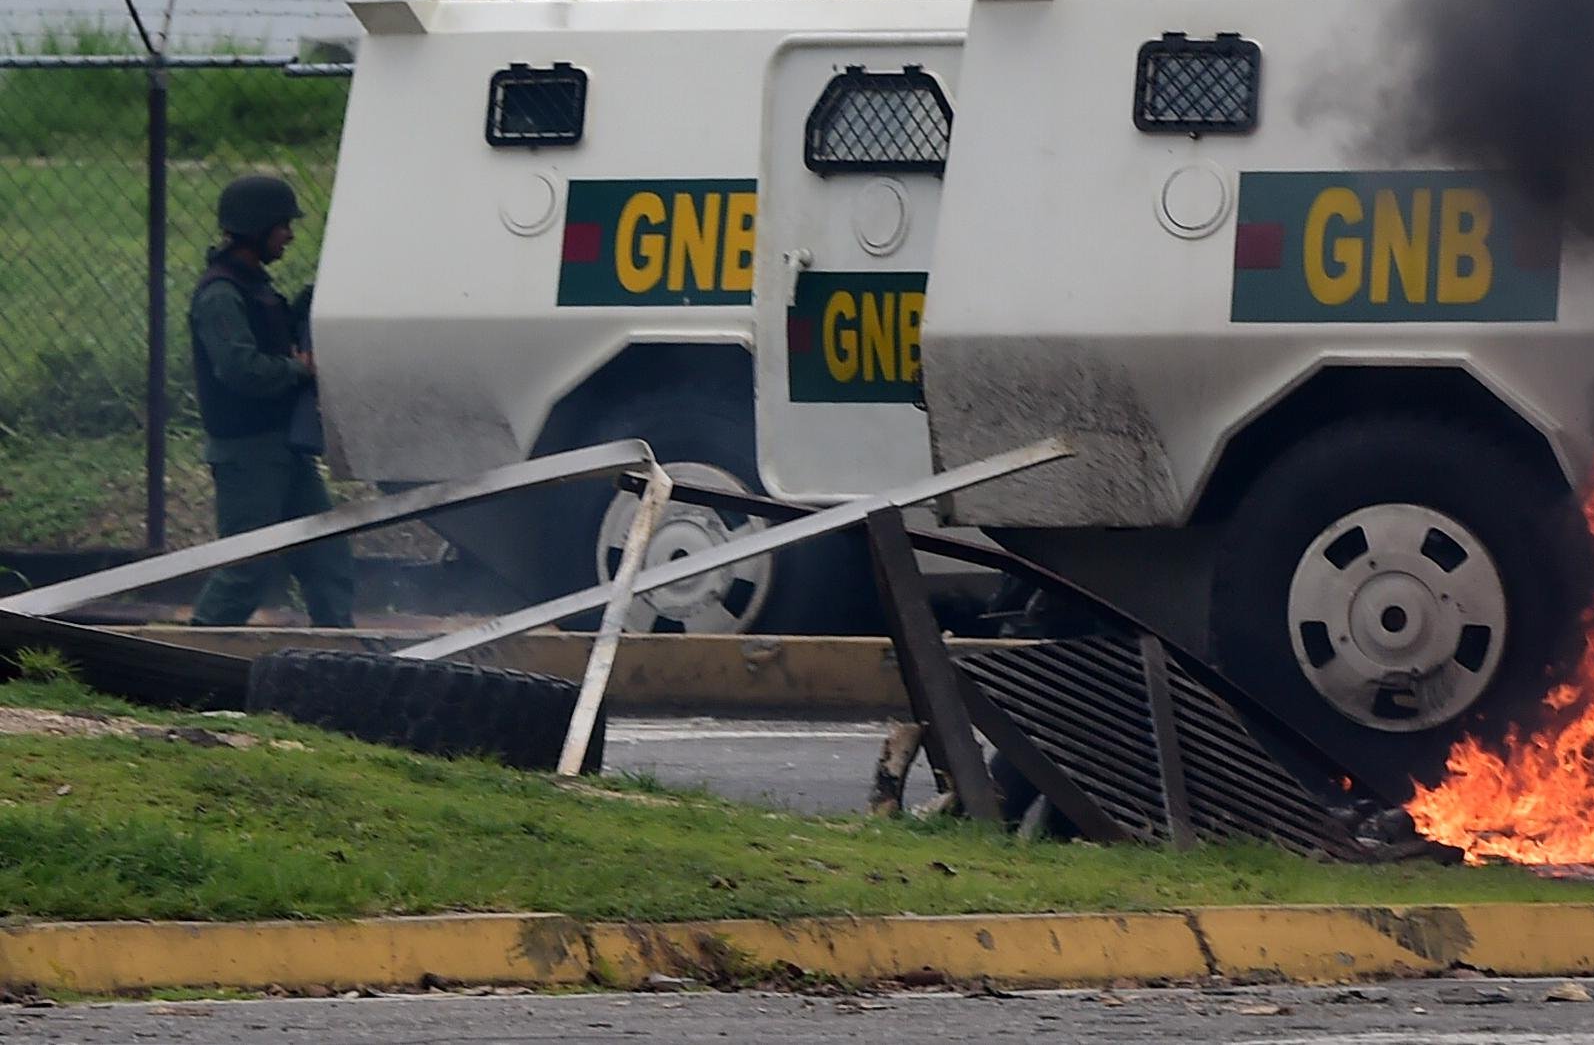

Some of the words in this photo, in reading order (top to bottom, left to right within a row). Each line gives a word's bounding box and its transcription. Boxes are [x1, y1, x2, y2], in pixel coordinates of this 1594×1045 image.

[615, 191, 758, 294] GNB
[1303, 186, 1493, 306] GNB
[823, 290, 925, 384] GNB
